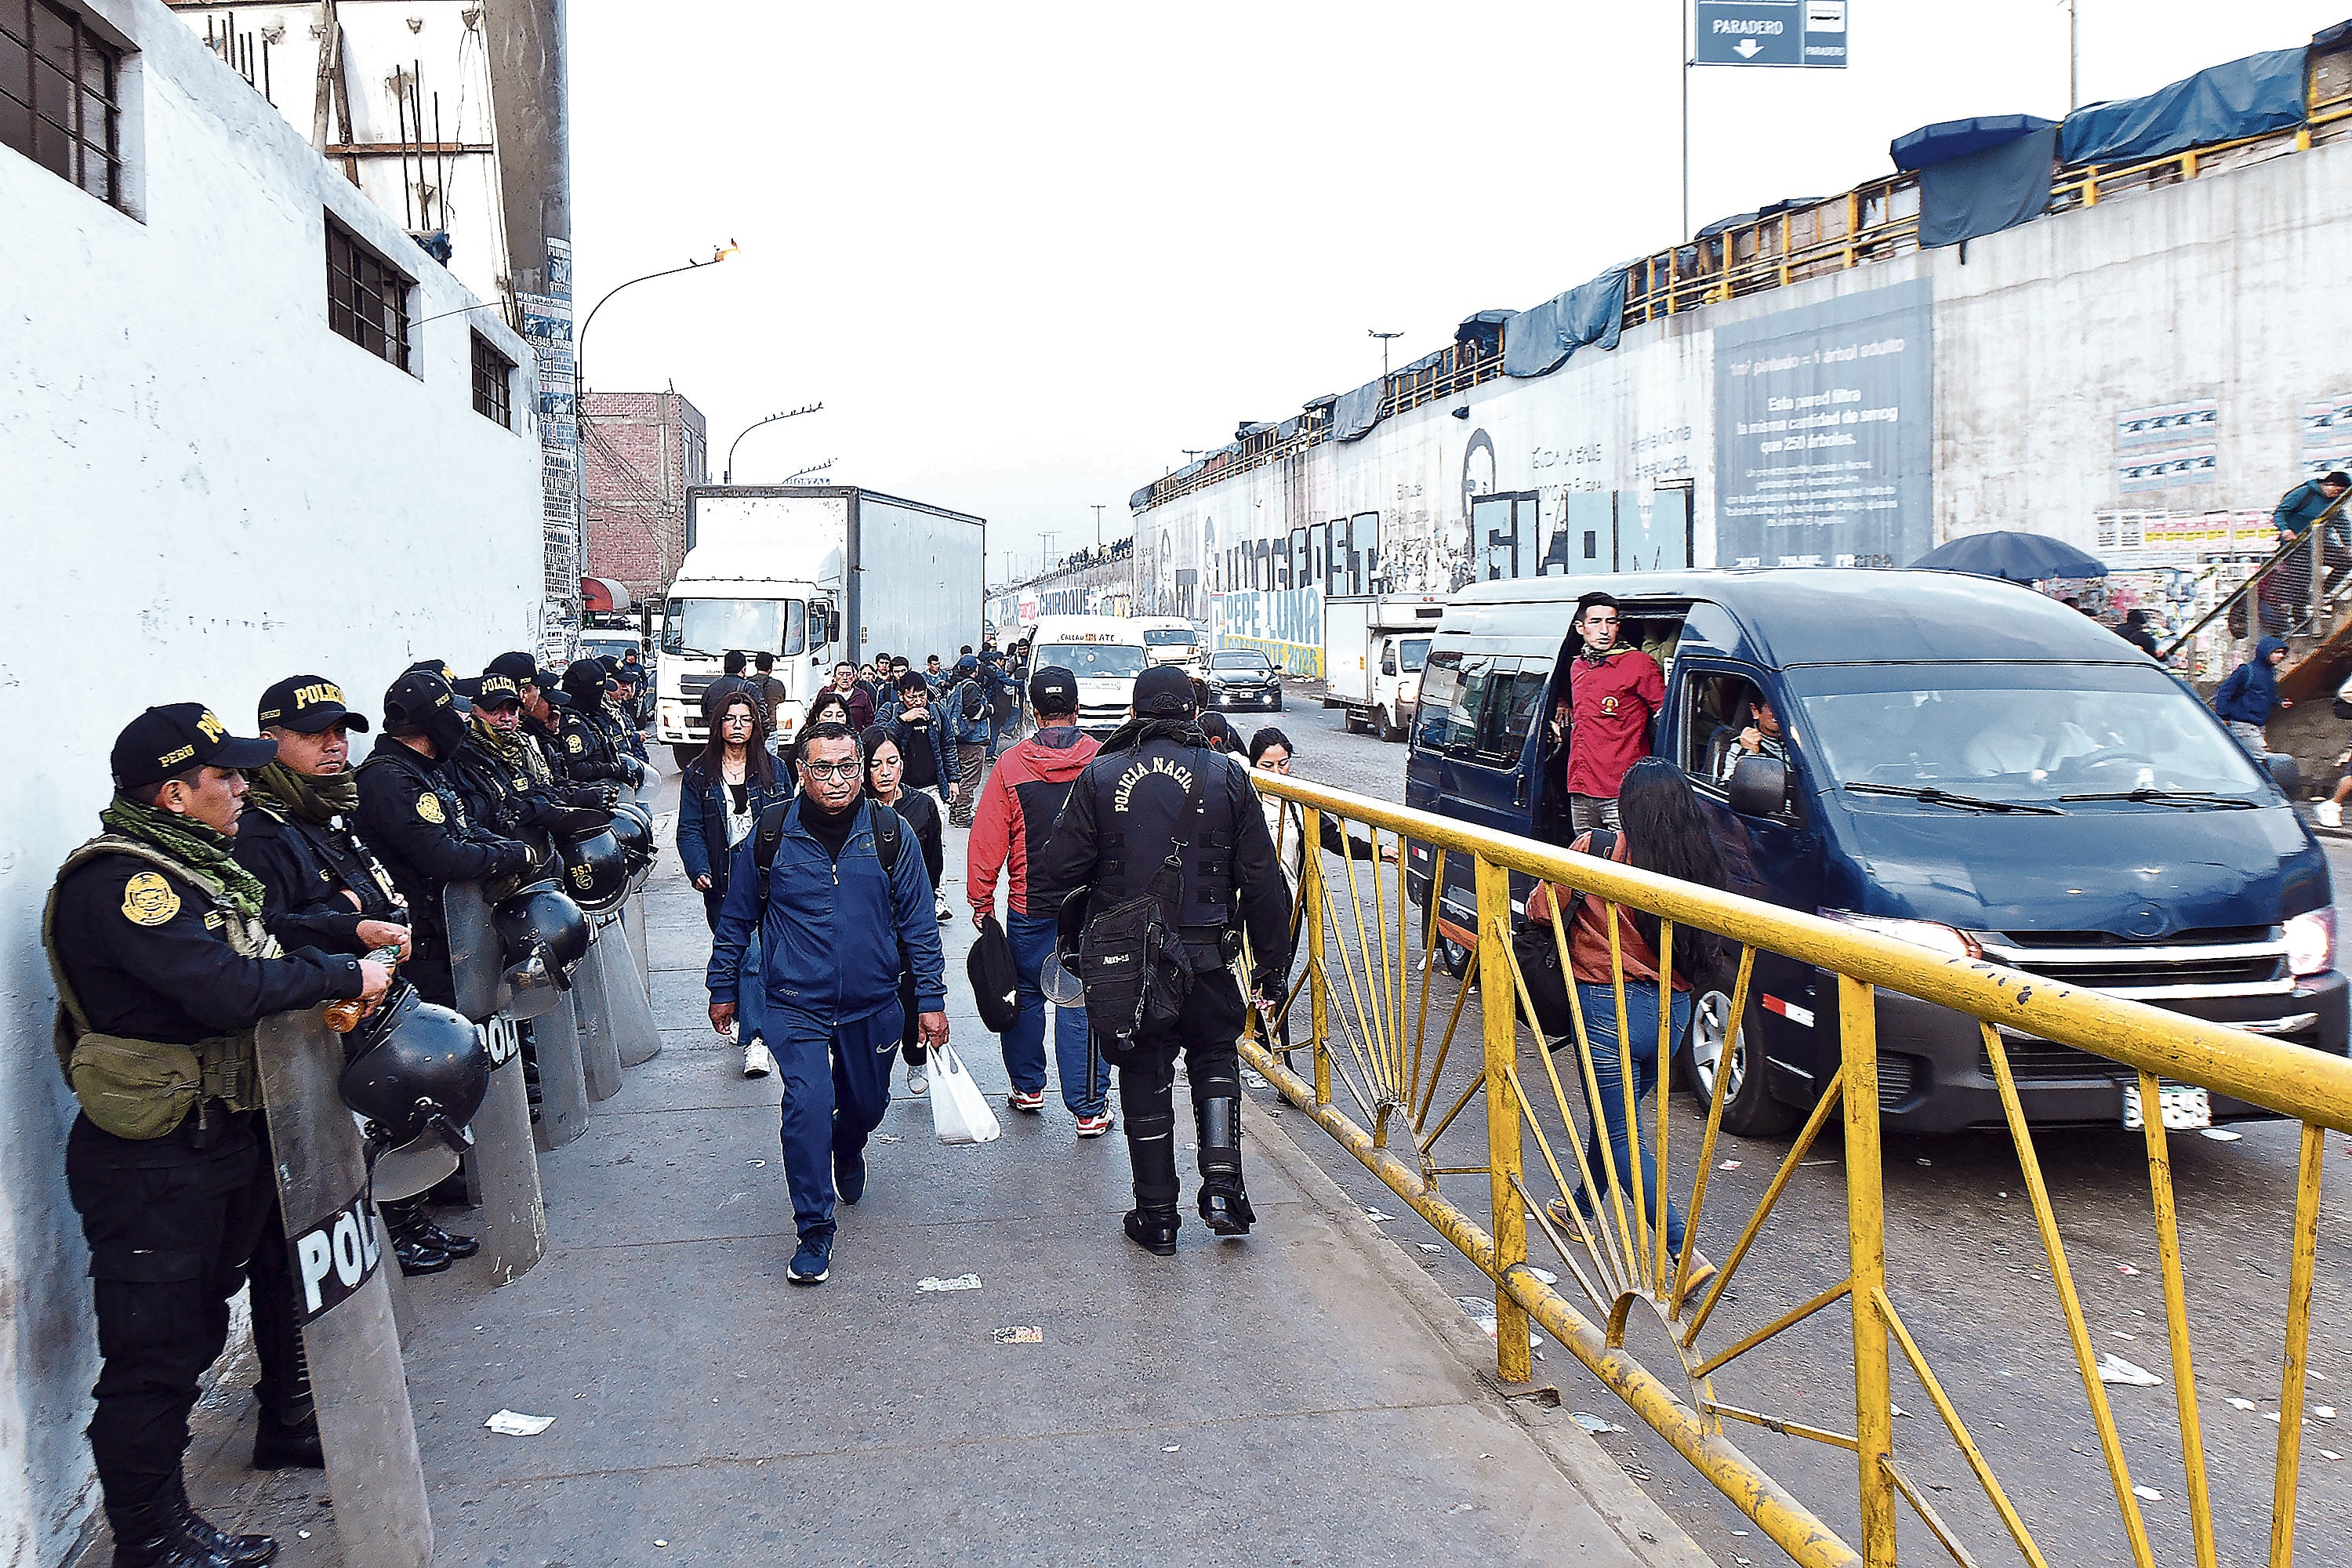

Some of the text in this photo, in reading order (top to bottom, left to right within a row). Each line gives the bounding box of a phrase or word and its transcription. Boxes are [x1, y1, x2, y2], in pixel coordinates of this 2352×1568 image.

[1713, 20, 1783, 34] PARADERO
[1842, 408, 1859, 424] de
[1860, 407, 1899, 423] smog
[1784, 435, 1806, 451] 250
[1040, 588, 1091, 616] CHIROQUE
[1226, 586, 1319, 645] PEPE LUNA
[1287, 644, 1318, 676] 2026
[1114, 761, 1149, 812] POLICIA
